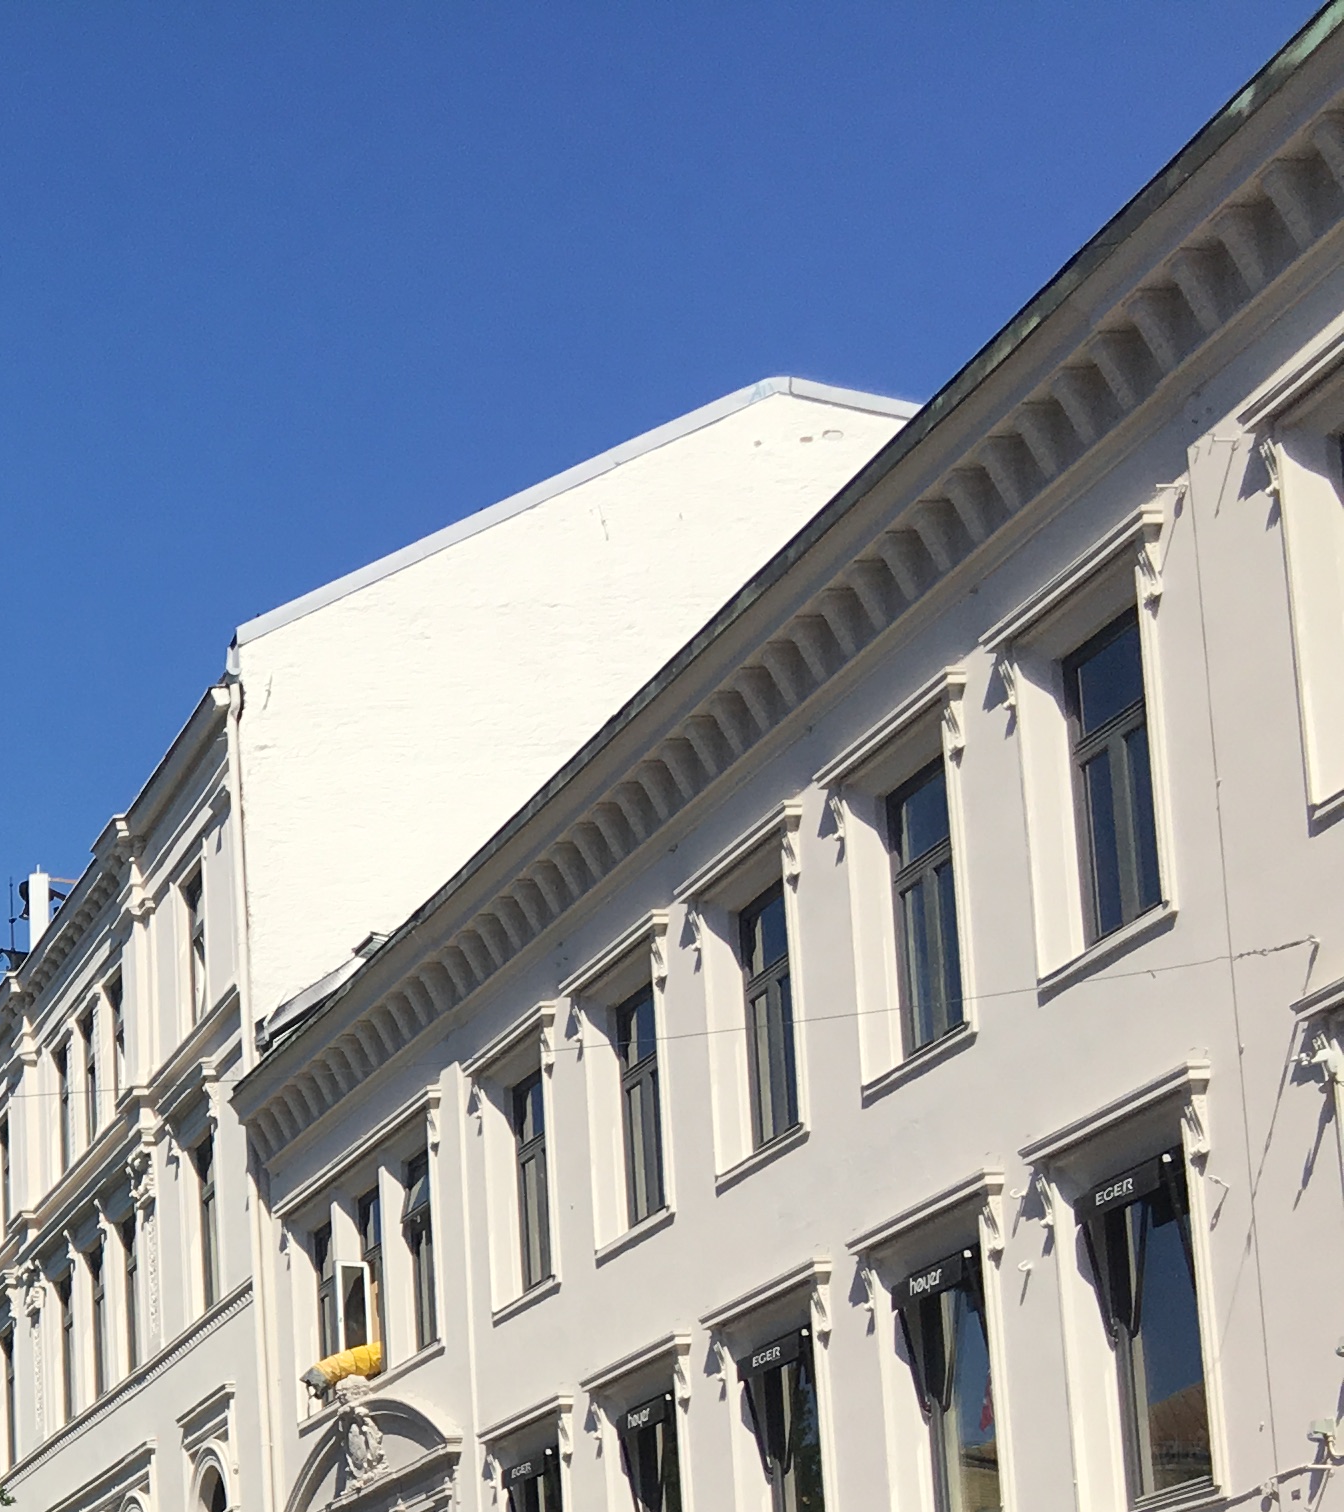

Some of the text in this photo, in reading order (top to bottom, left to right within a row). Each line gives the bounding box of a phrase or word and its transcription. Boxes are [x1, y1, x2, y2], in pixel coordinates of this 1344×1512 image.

[1095, 1177, 1133, 1206] EGER
[752, 1346, 781, 1368] EGER
[511, 1462, 532, 1479] EGER
